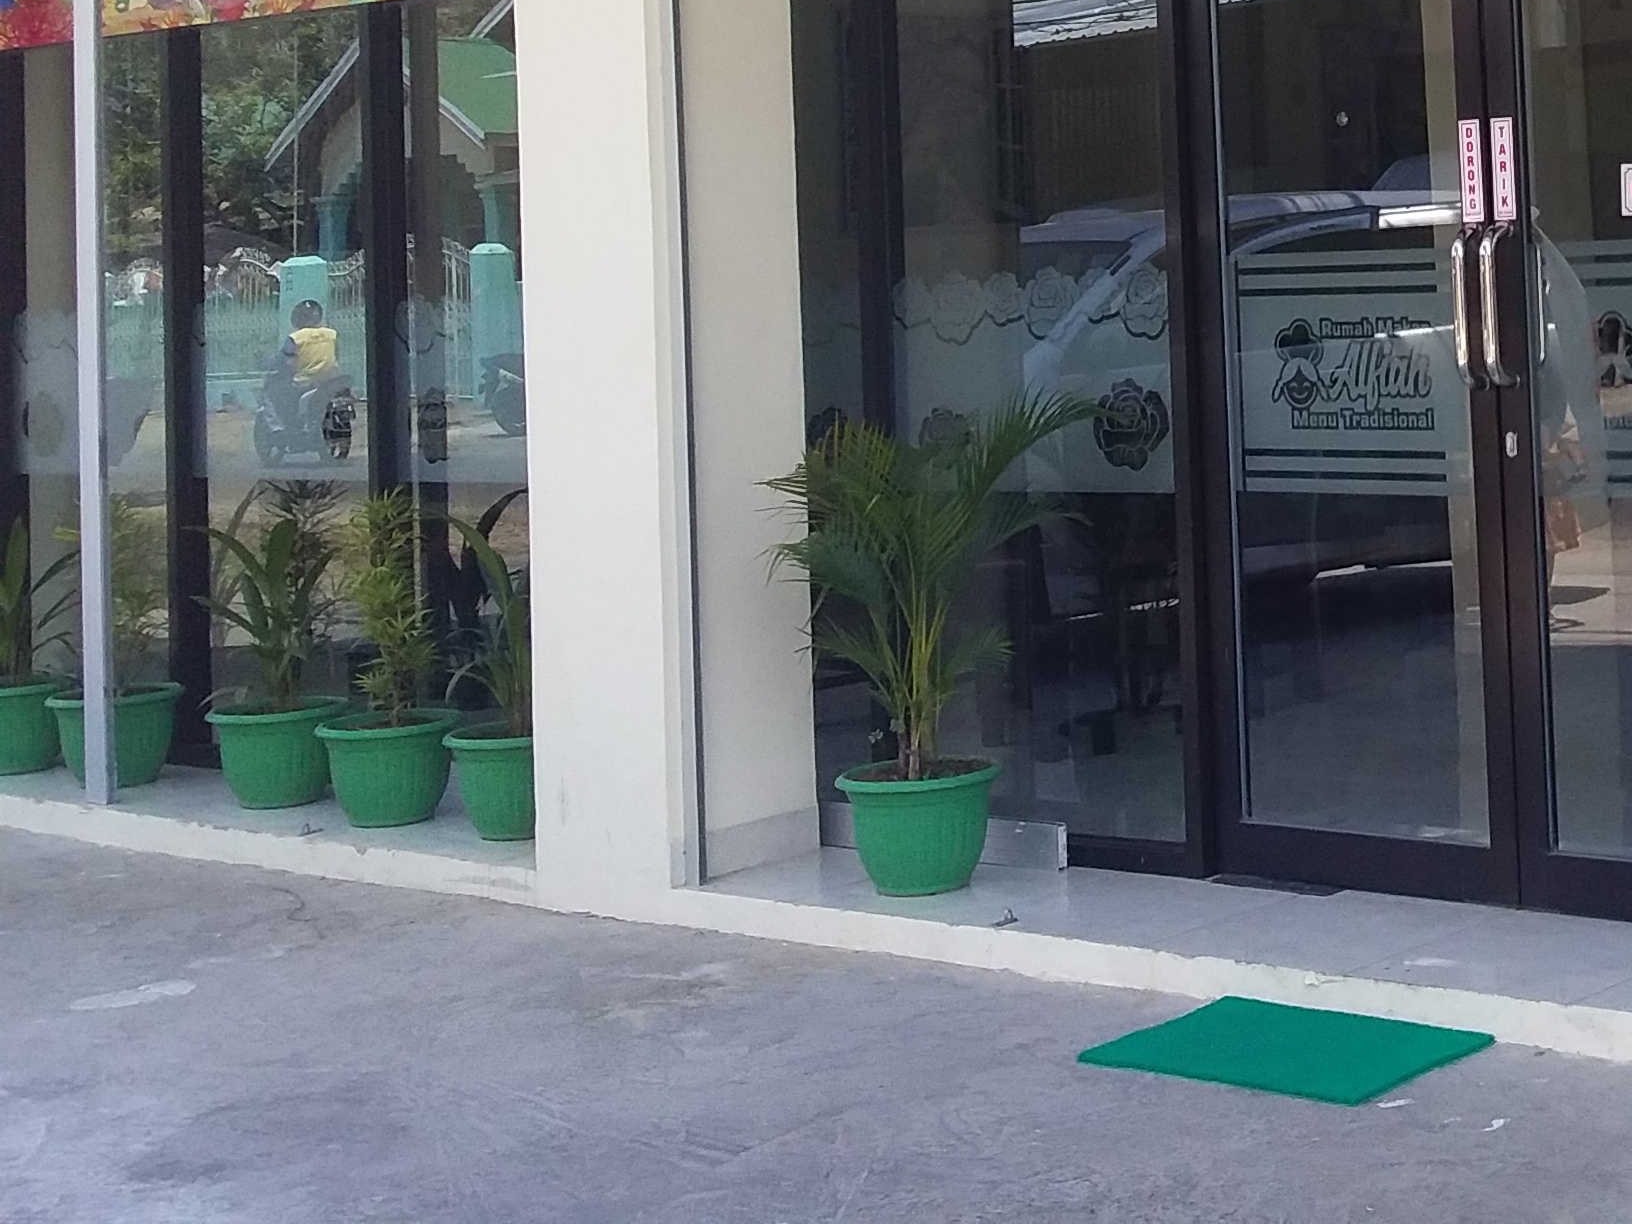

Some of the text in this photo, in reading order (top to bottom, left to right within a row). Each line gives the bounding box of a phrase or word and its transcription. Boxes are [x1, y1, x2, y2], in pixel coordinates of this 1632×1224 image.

[1465, 127, 1477, 210] DORONG
[1498, 126, 1509, 208] TARIK
[1319, 317, 1375, 339] Rumah
[1292, 407, 1435, 430] Menu Tradisional
